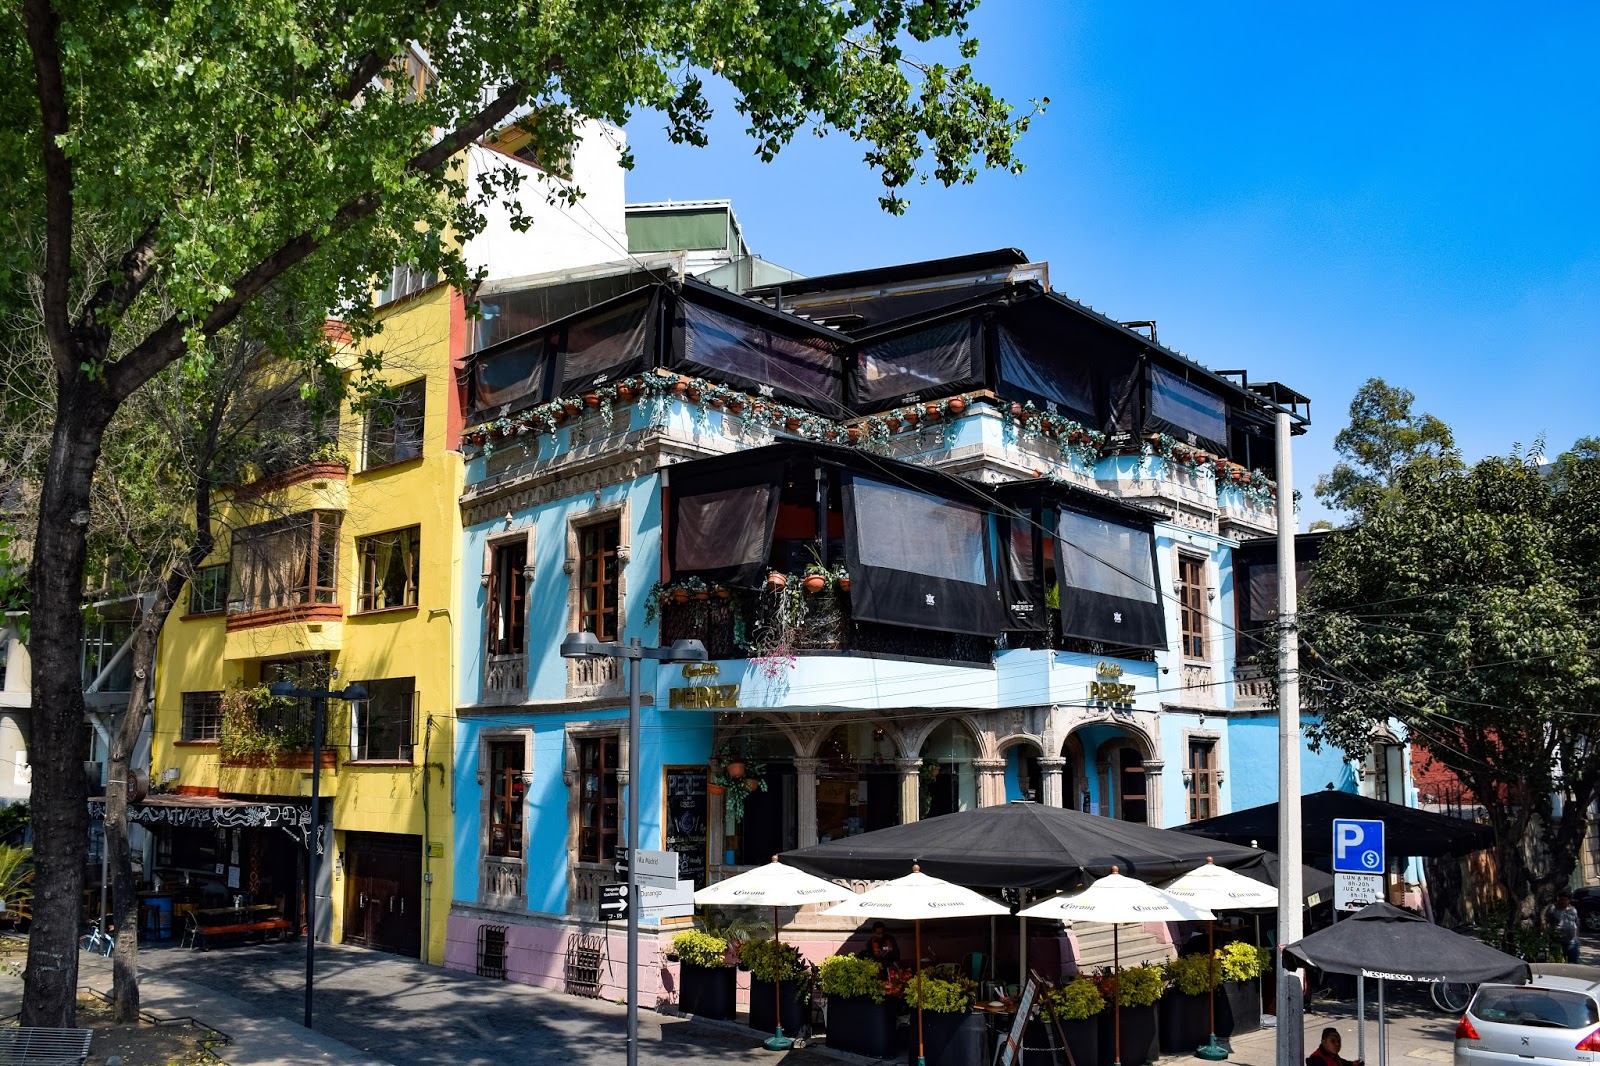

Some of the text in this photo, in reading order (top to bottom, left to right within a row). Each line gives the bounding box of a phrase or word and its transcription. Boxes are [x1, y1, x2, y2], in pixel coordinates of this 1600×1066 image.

[1011, 604, 1034, 612] PEREZ
[669, 684, 740, 709] PEREZ
[1086, 681, 1136, 704] PEREZ
[1337, 823, 1365, 859] P
[640, 890, 662, 898] Durango
[796, 888, 827, 896] Corona
[1060, 902, 1096, 911] Corona
[1132, 904, 1170, 912] Corona
[1361, 968, 1415, 982] NESPRESSO
